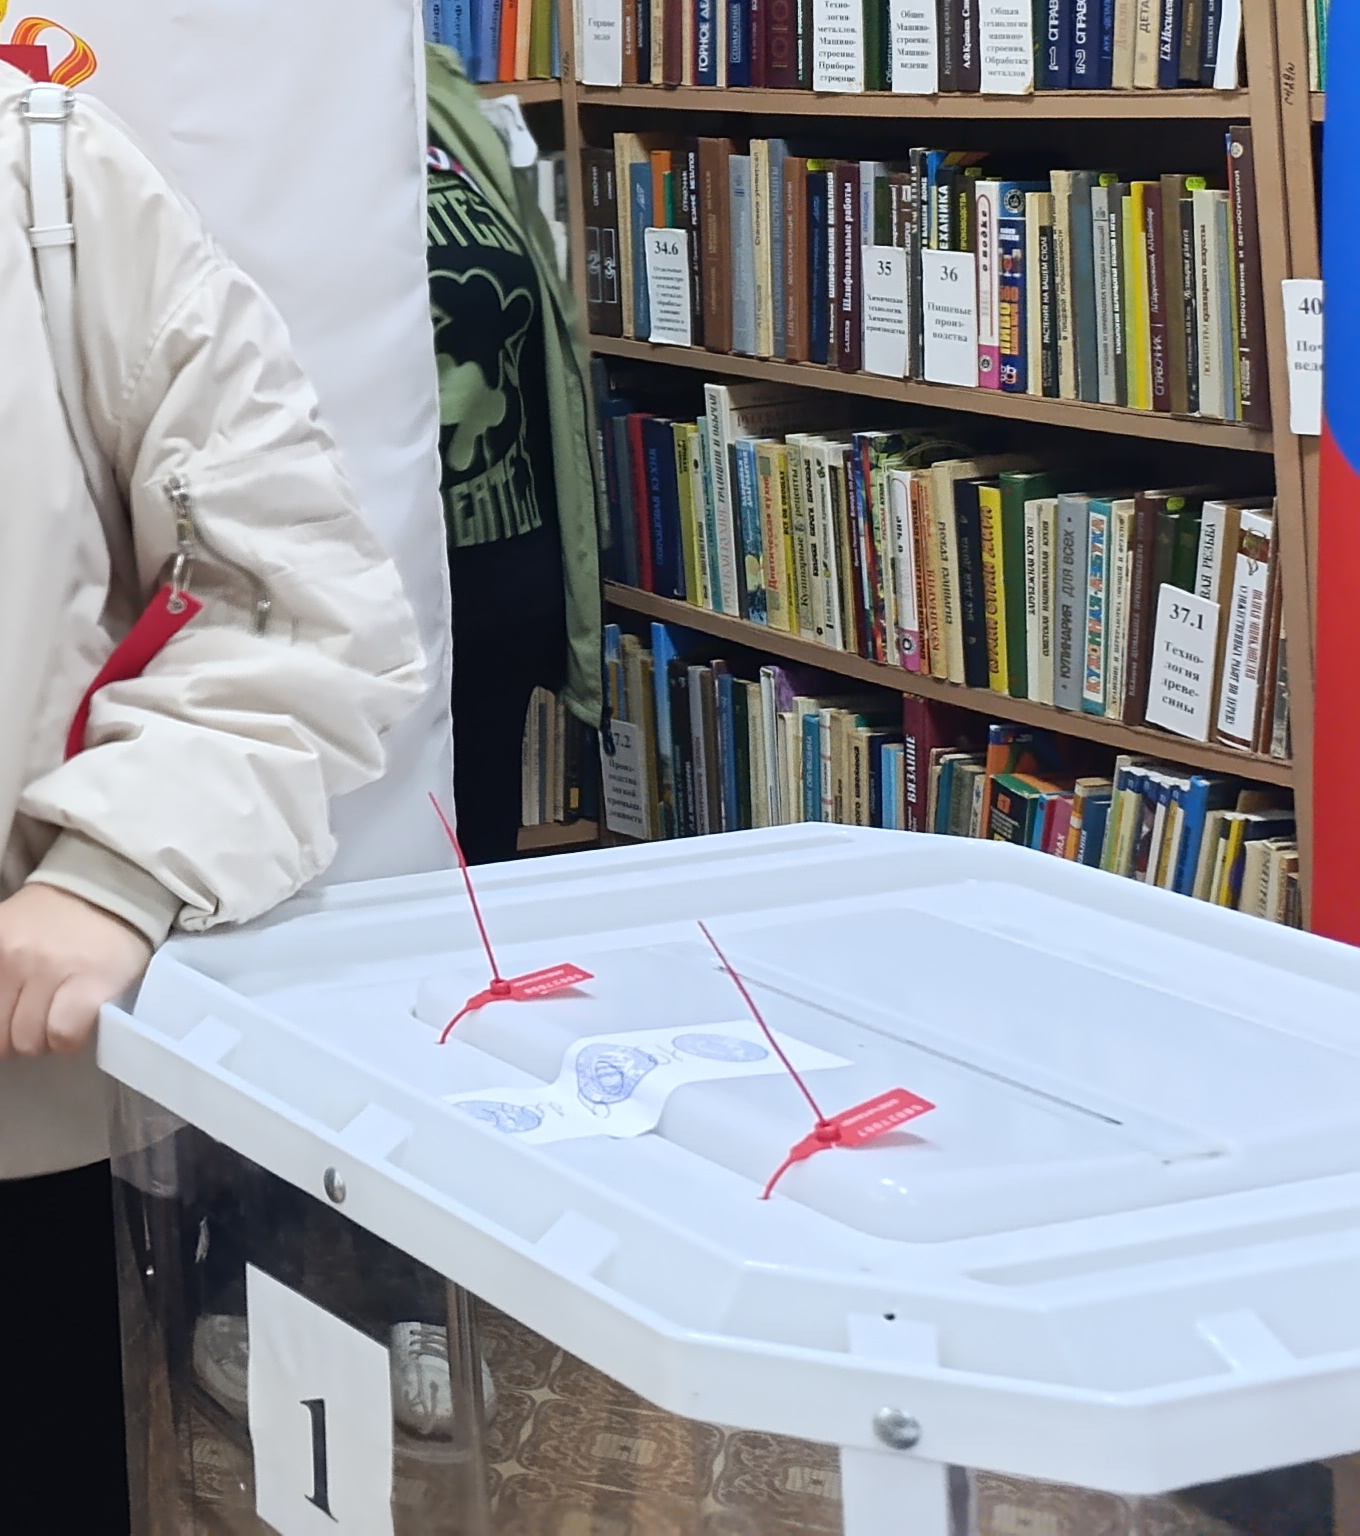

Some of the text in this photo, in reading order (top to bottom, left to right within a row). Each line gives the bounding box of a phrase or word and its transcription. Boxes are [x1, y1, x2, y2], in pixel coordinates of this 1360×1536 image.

[825, 0, 850, 10] Техно-
[896, 23, 930, 33] Машино-
[699, 23, 709, 72] ГОРНОЕ
[819, 37, 857, 47] Машино-
[819, 50, 855, 60] строение.
[897, 48, 932, 58] Машино-
[818, 62, 856, 74] Приборо-
[819, 74, 855, 84] строение
[937, 185, 949, 250] ЕХАНИКА
[654, 240, 679, 256] 34.6
[841, 182, 853, 311] Шлифовальные работы
[877, 260, 892, 276] 35
[940, 266, 958, 283] 36
[1040, 236, 1051, 343] РАСТЕНИЯ НА ВАШЕМ СТОЛЕ
[927, 301, 972, 317] Пищевые
[1298, 298, 1323, 316] 40
[935, 318, 965, 329] произ-
[932, 329, 968, 343] водства
[1201, 523, 1217, 568] РЕЗЬБА
[1061, 569, 1074, 597] ДЛЯ
[1169, 603, 1205, 630] 37.1
[1060, 604, 1072, 678] КУЛИНАРИЯ
[1165, 639, 1204, 664] Техно-
[1165, 660, 1200, 683] логия
[1160, 677, 1199, 699] древе-
[1162, 692, 1195, 715] сины
[906, 733, 917, 803] ВЯЗАНИЕ
[300, 1398, 339, 1523] 1
